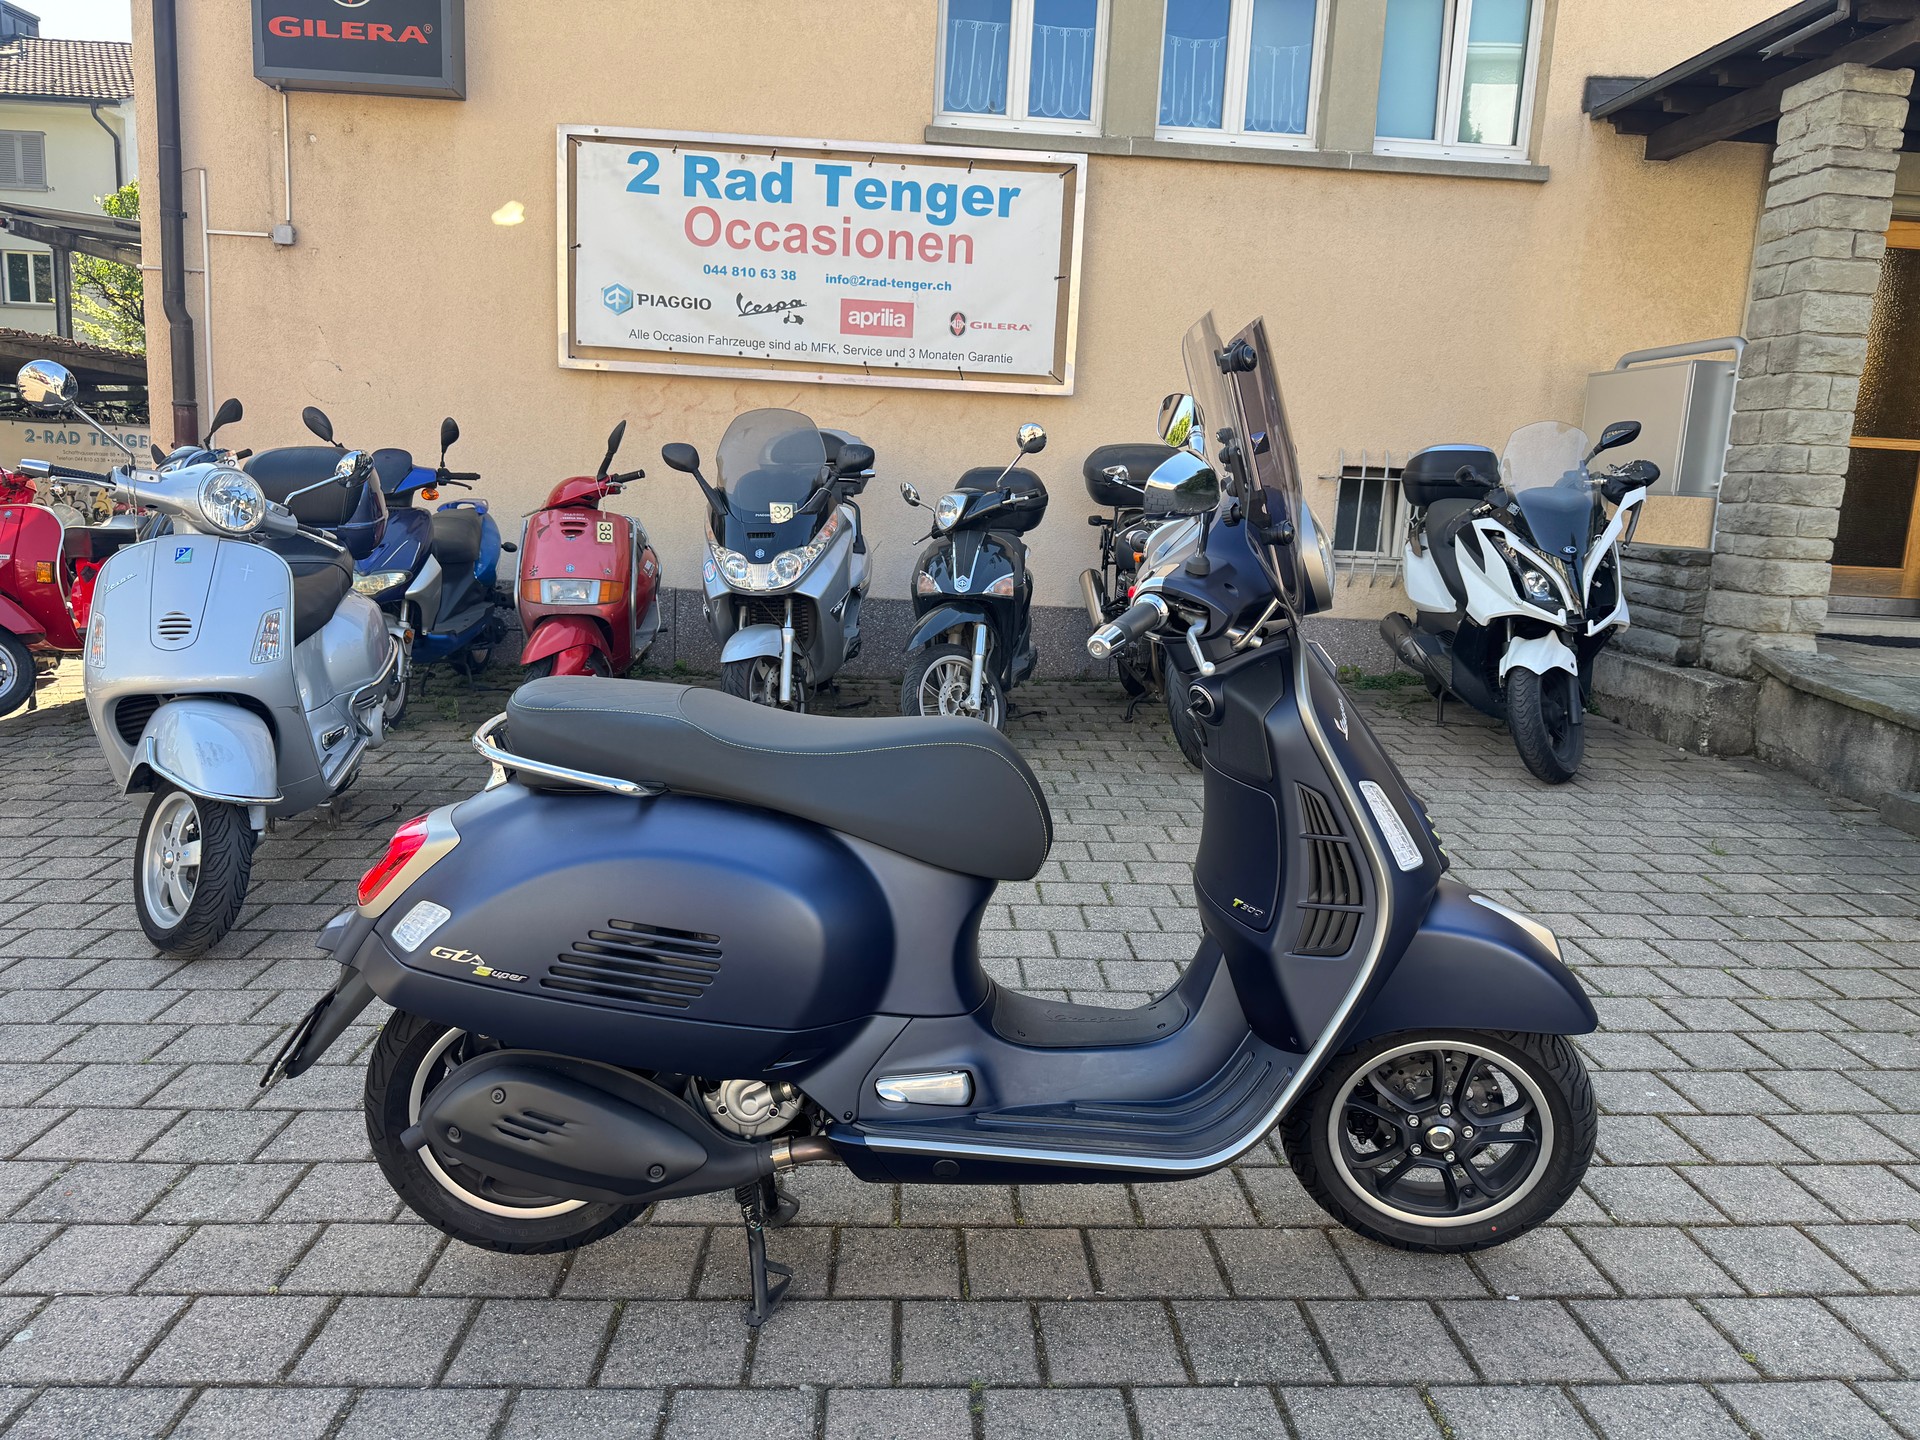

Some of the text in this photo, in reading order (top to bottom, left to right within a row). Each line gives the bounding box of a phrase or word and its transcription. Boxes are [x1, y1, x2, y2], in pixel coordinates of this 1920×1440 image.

[625, 150, 1022, 227] 2 Rad Tenger
[684, 205, 974, 265] Occasionen
[703, 264, 797, 281] 044 810 63 38
[825, 273, 952, 292] info@2rad-tenger.ch
[636, 293, 712, 311] PIAGGIO
[735, 292, 808, 317] Vespa
[847, 307, 907, 329] aprilia
[629, 329, 1013, 364] Alle Occasion Fahrzeuge sind ab MFK, Service und 3 Monaten Garantie
[24, 428, 150, 449] 2-RAD TENGE
[773, 505, 791, 519] 32
[599, 523, 612, 541] 38
[472, 965, 528, 982] Super
